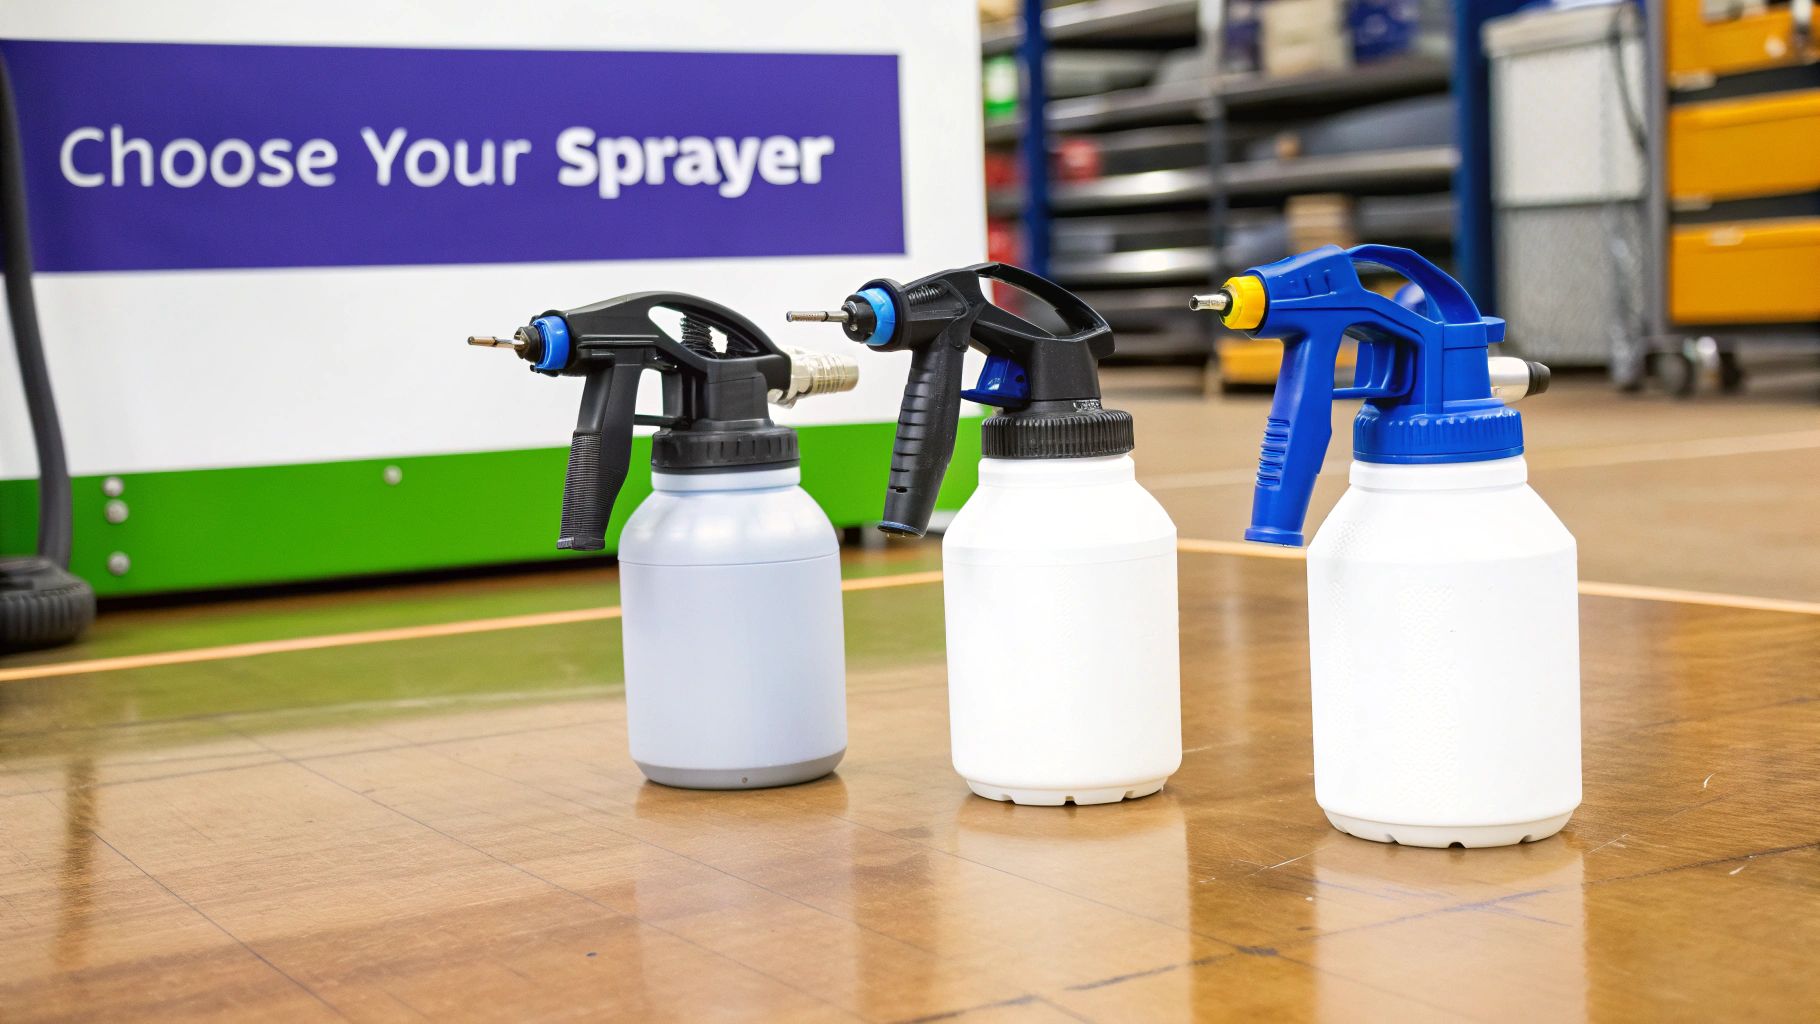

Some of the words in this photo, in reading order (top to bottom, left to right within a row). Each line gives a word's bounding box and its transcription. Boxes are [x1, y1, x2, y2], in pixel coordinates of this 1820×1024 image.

[60, 125, 338, 188] Choose
[361, 127, 531, 187] Your
[556, 126, 835, 199] Sprayer
